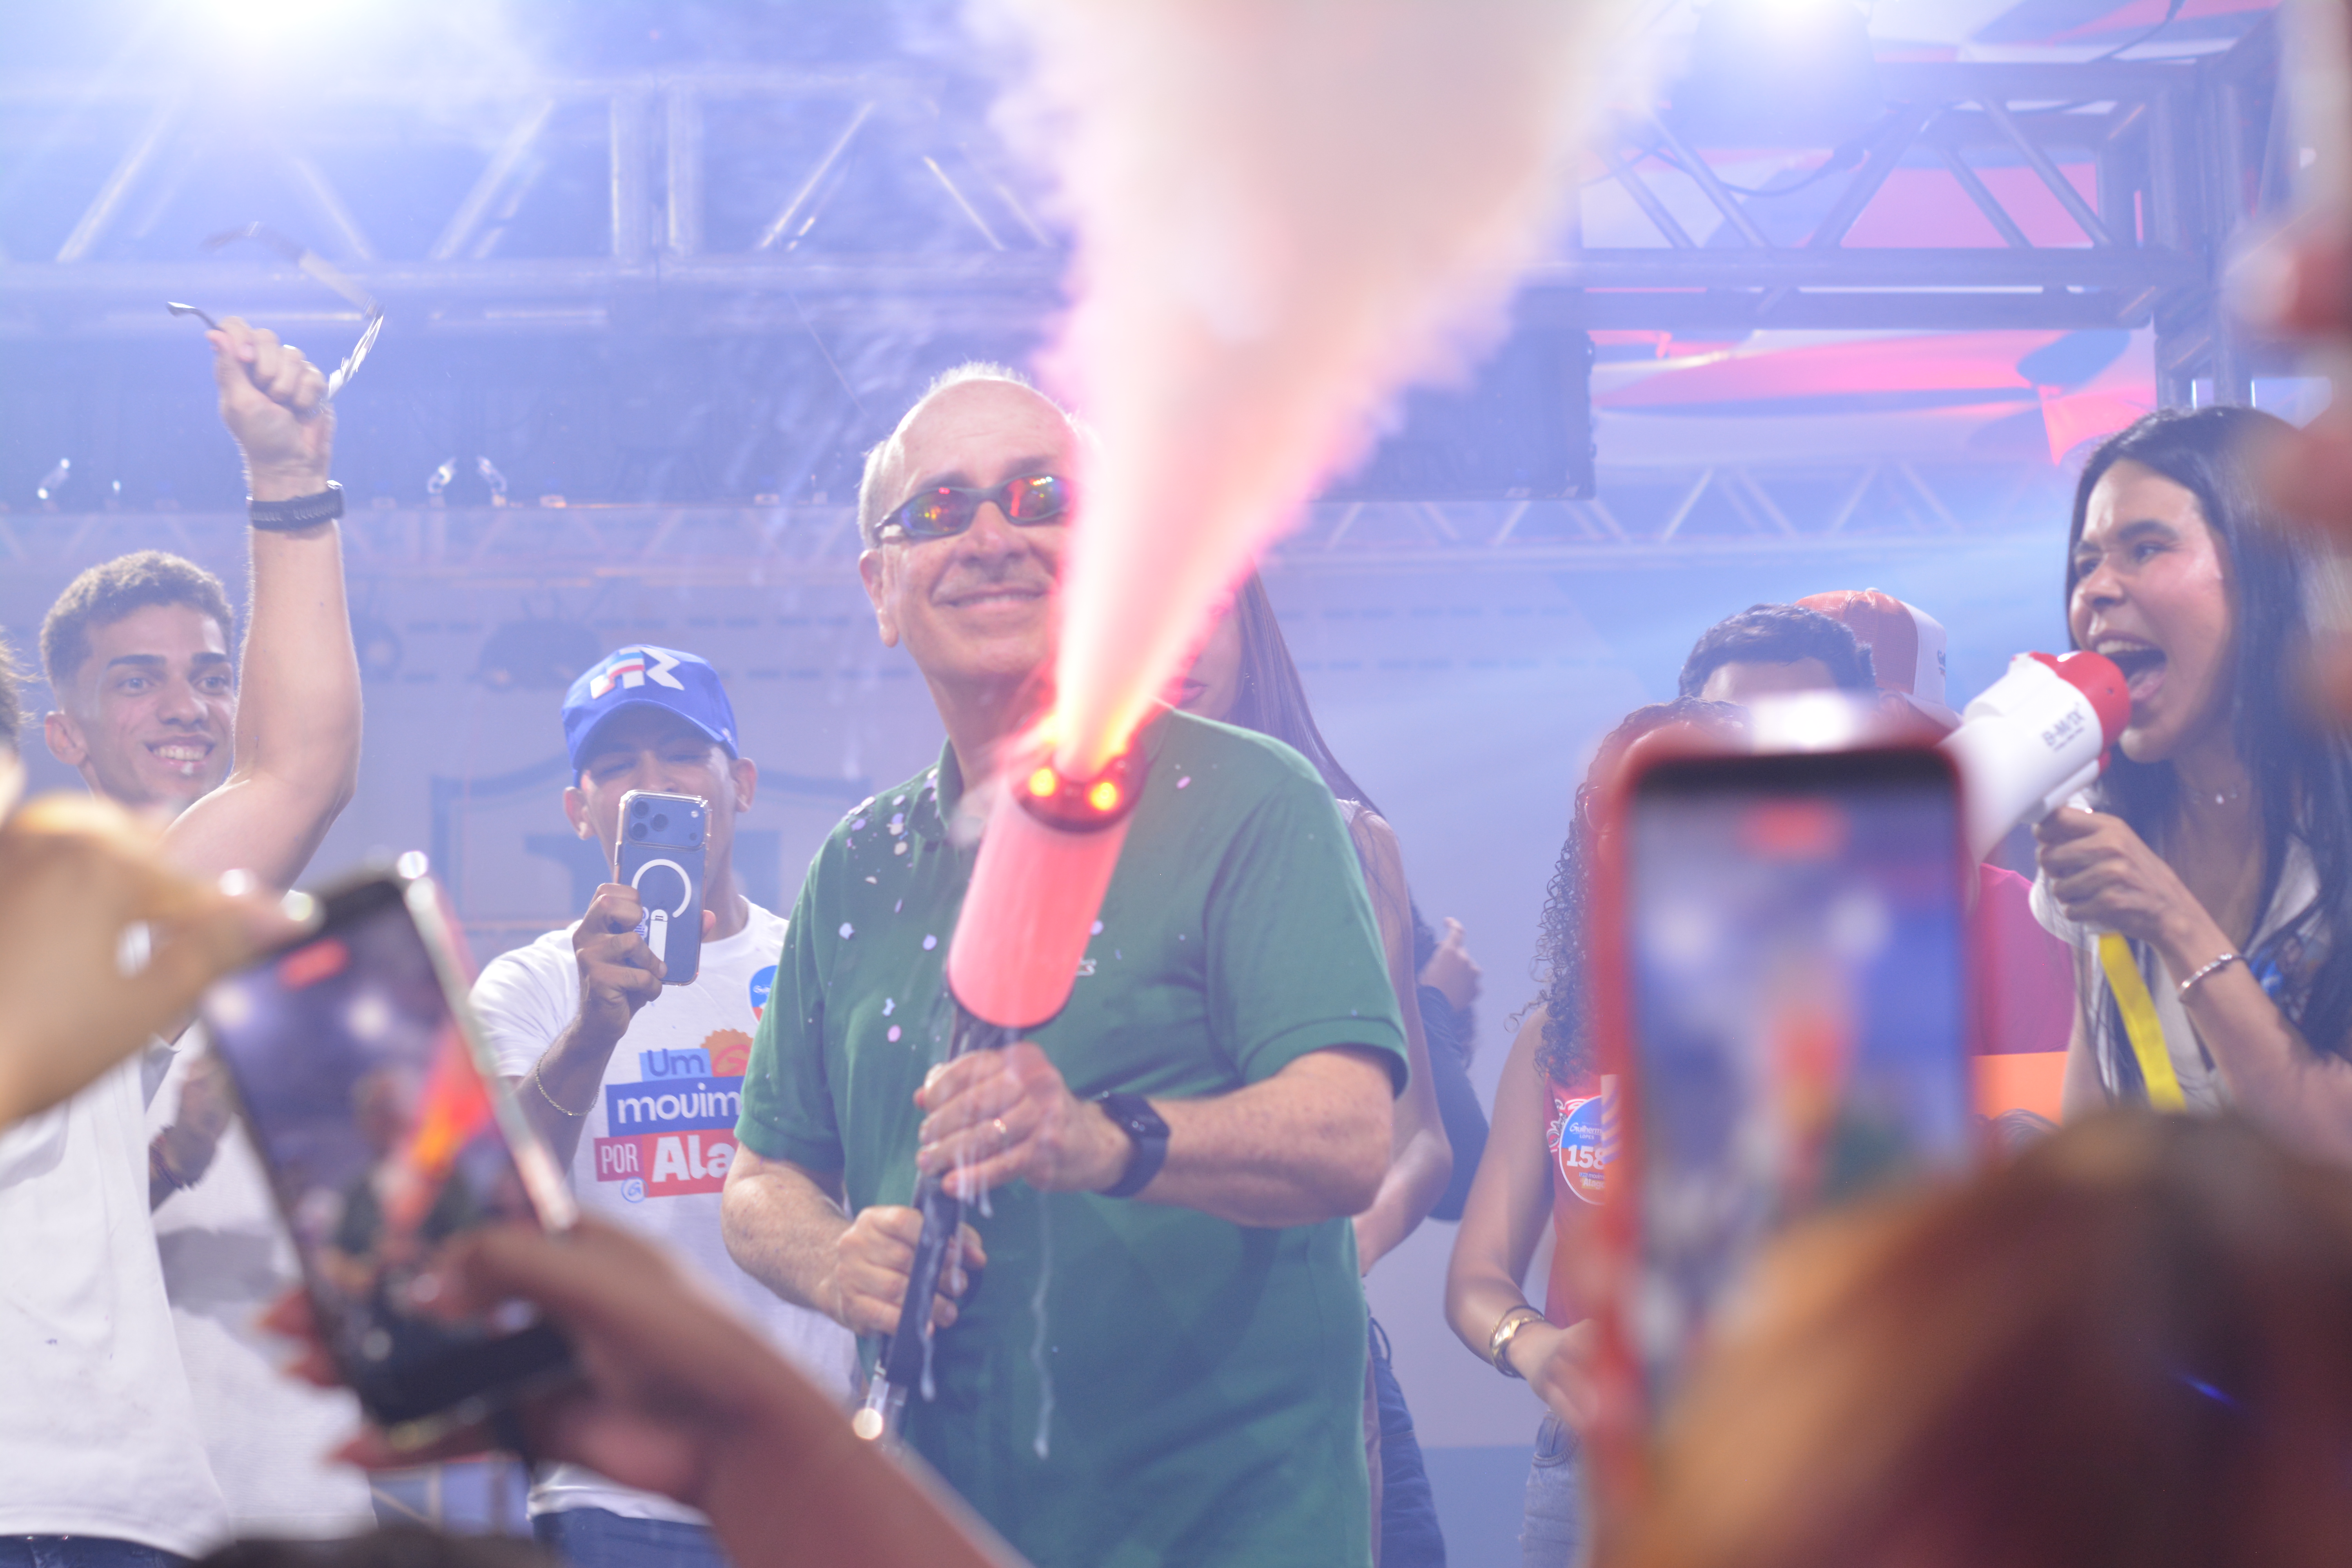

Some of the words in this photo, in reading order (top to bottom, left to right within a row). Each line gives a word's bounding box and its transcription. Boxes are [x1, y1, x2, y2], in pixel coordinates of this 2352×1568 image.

[647, 1048, 705, 1077] Um
[617, 1082, 741, 1124] movim
[1570, 1122, 1602, 1134] Guilherm
[601, 1143, 640, 1174] POR
[652, 1134, 736, 1183] Ala
[1566, 1145, 1604, 1170] 158
